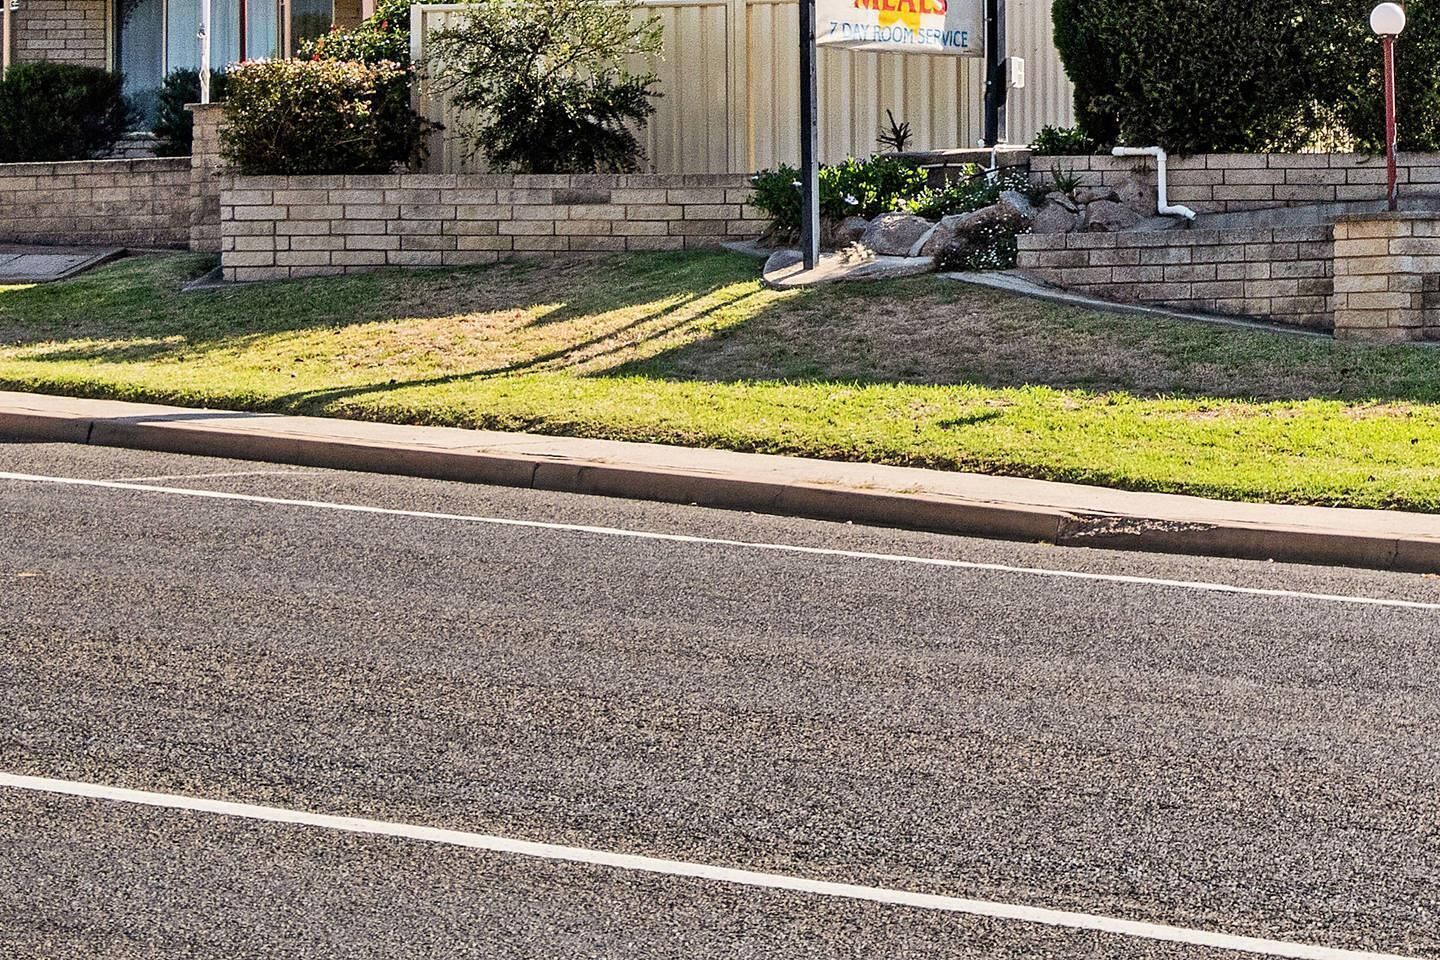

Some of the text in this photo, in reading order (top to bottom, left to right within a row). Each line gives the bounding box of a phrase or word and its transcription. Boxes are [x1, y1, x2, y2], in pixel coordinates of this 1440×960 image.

[830, 22, 969, 48] 7 DAY ROOM SERVICE
